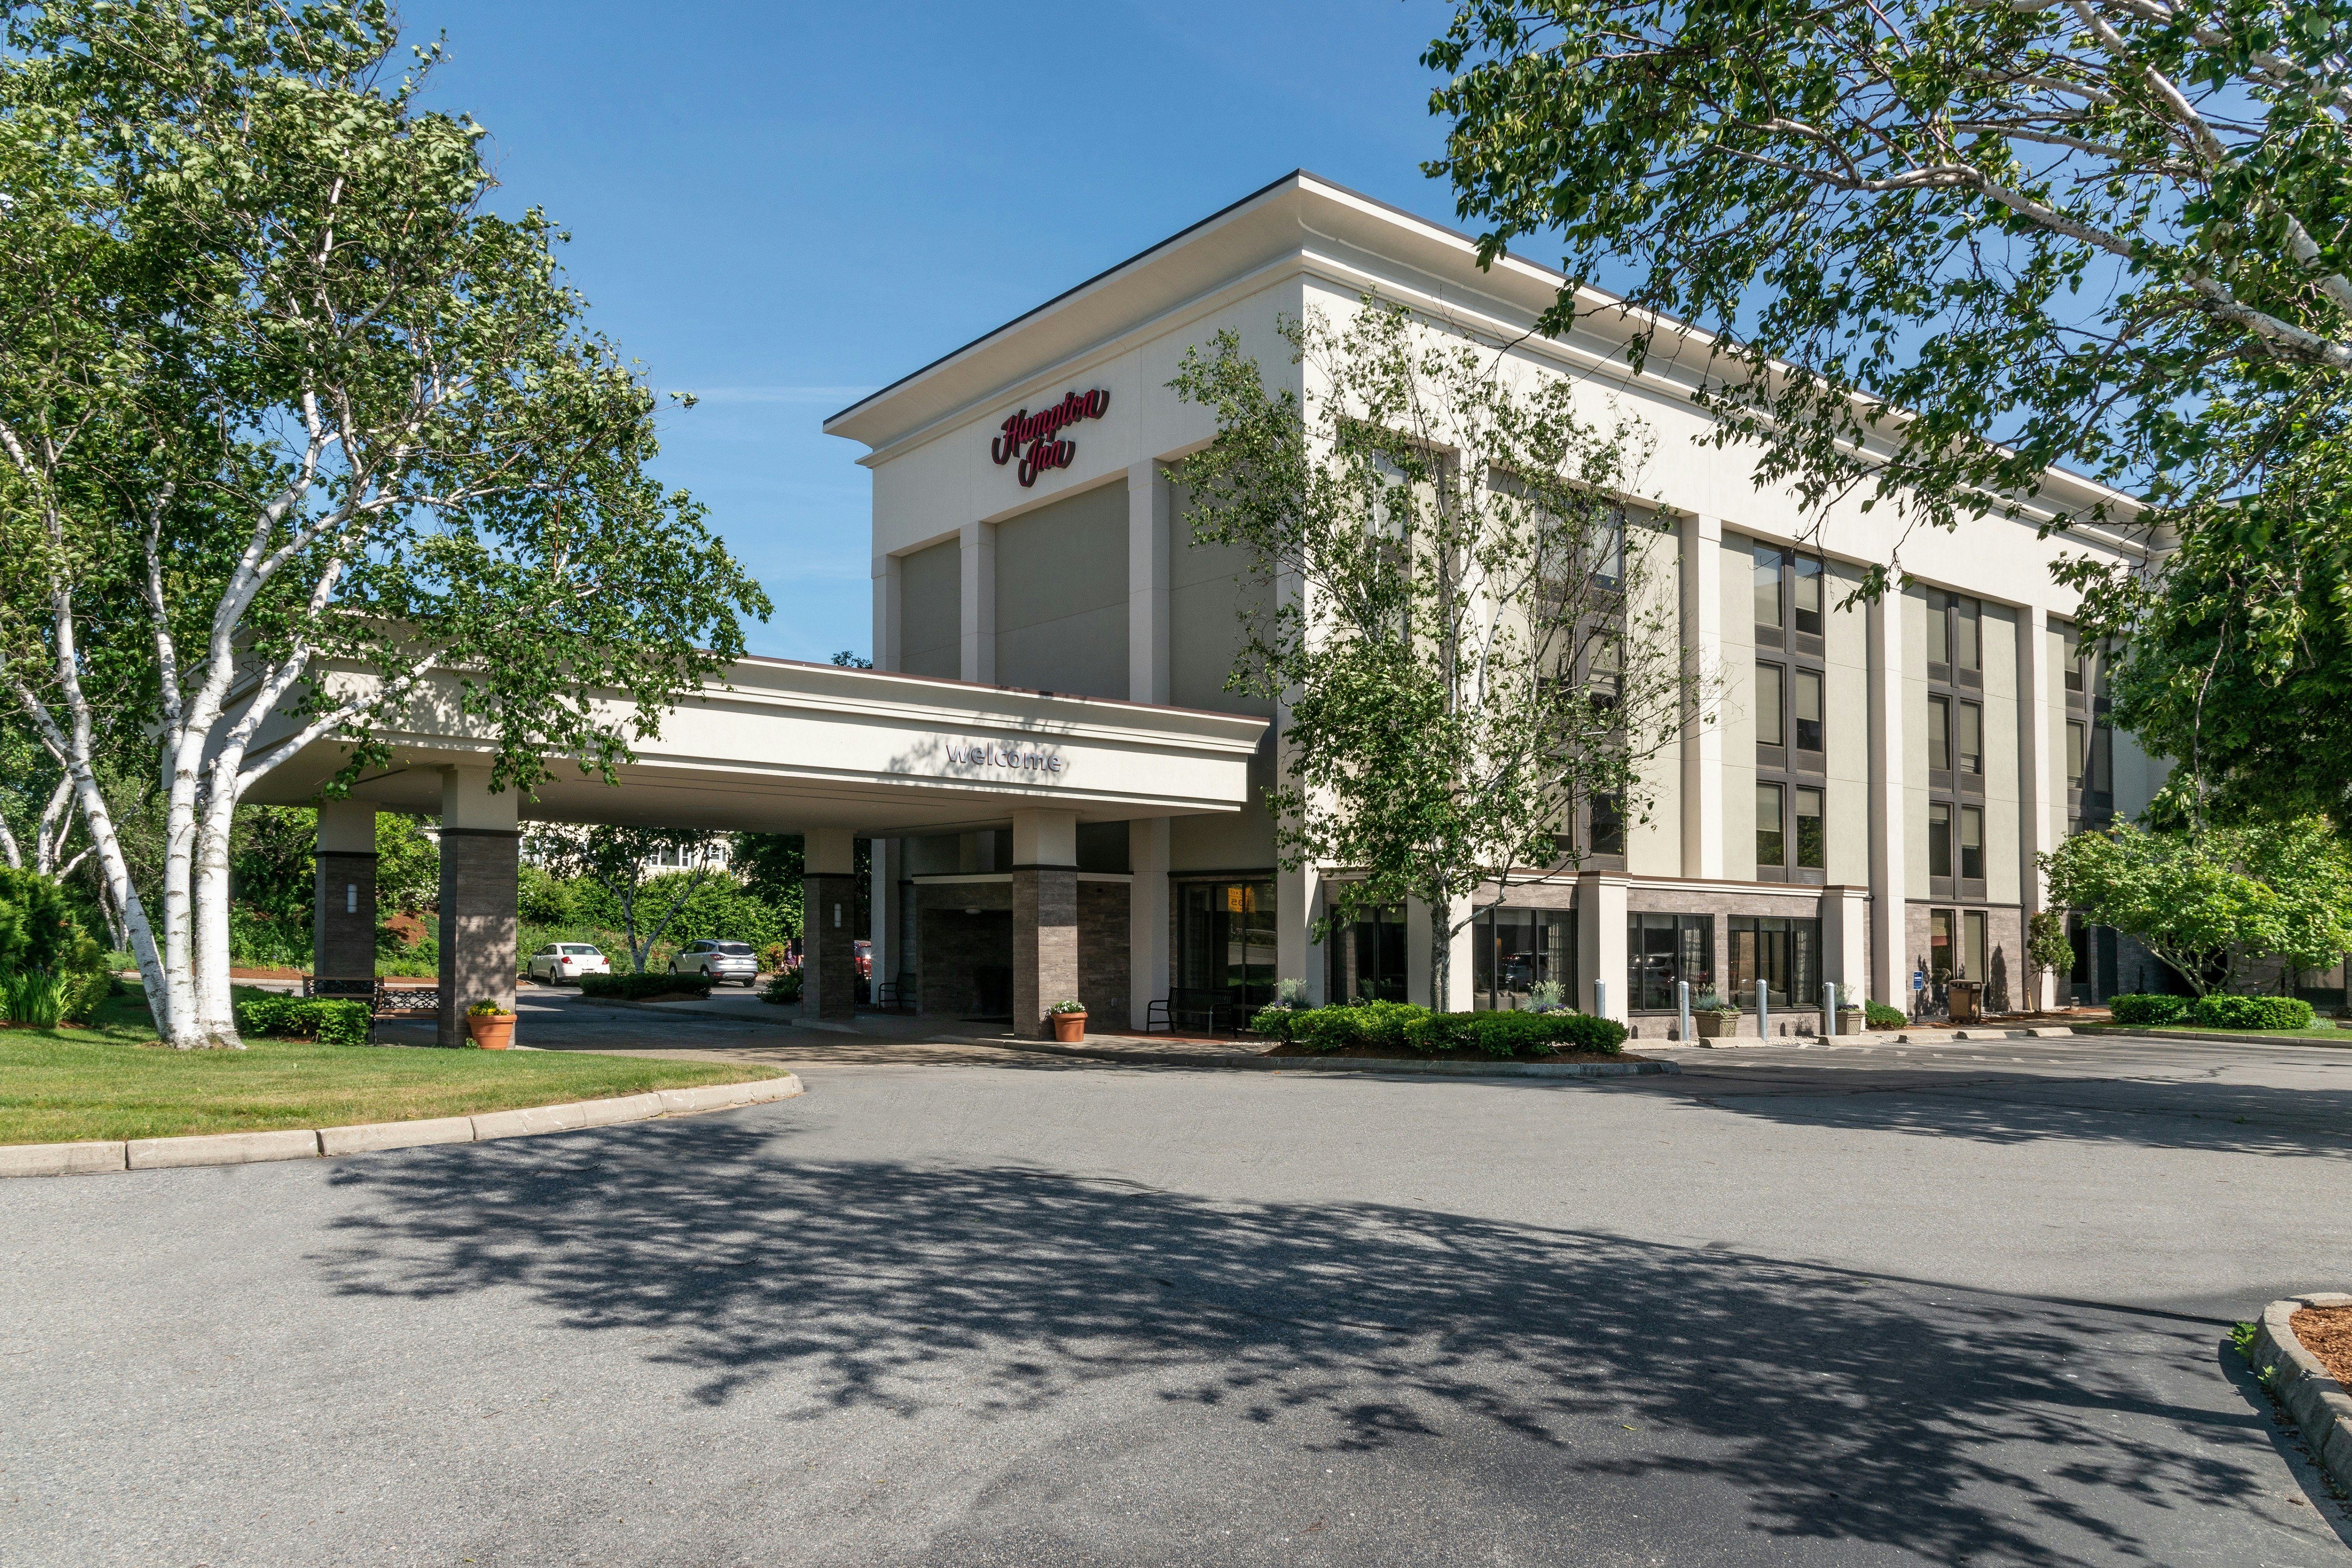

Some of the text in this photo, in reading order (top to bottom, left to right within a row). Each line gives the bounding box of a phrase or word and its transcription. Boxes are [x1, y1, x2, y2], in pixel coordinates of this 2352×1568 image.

[992, 389, 1110, 465] Hampton
[1018, 437, 1075, 487] Inn
[946, 742, 1061, 772] welcome
